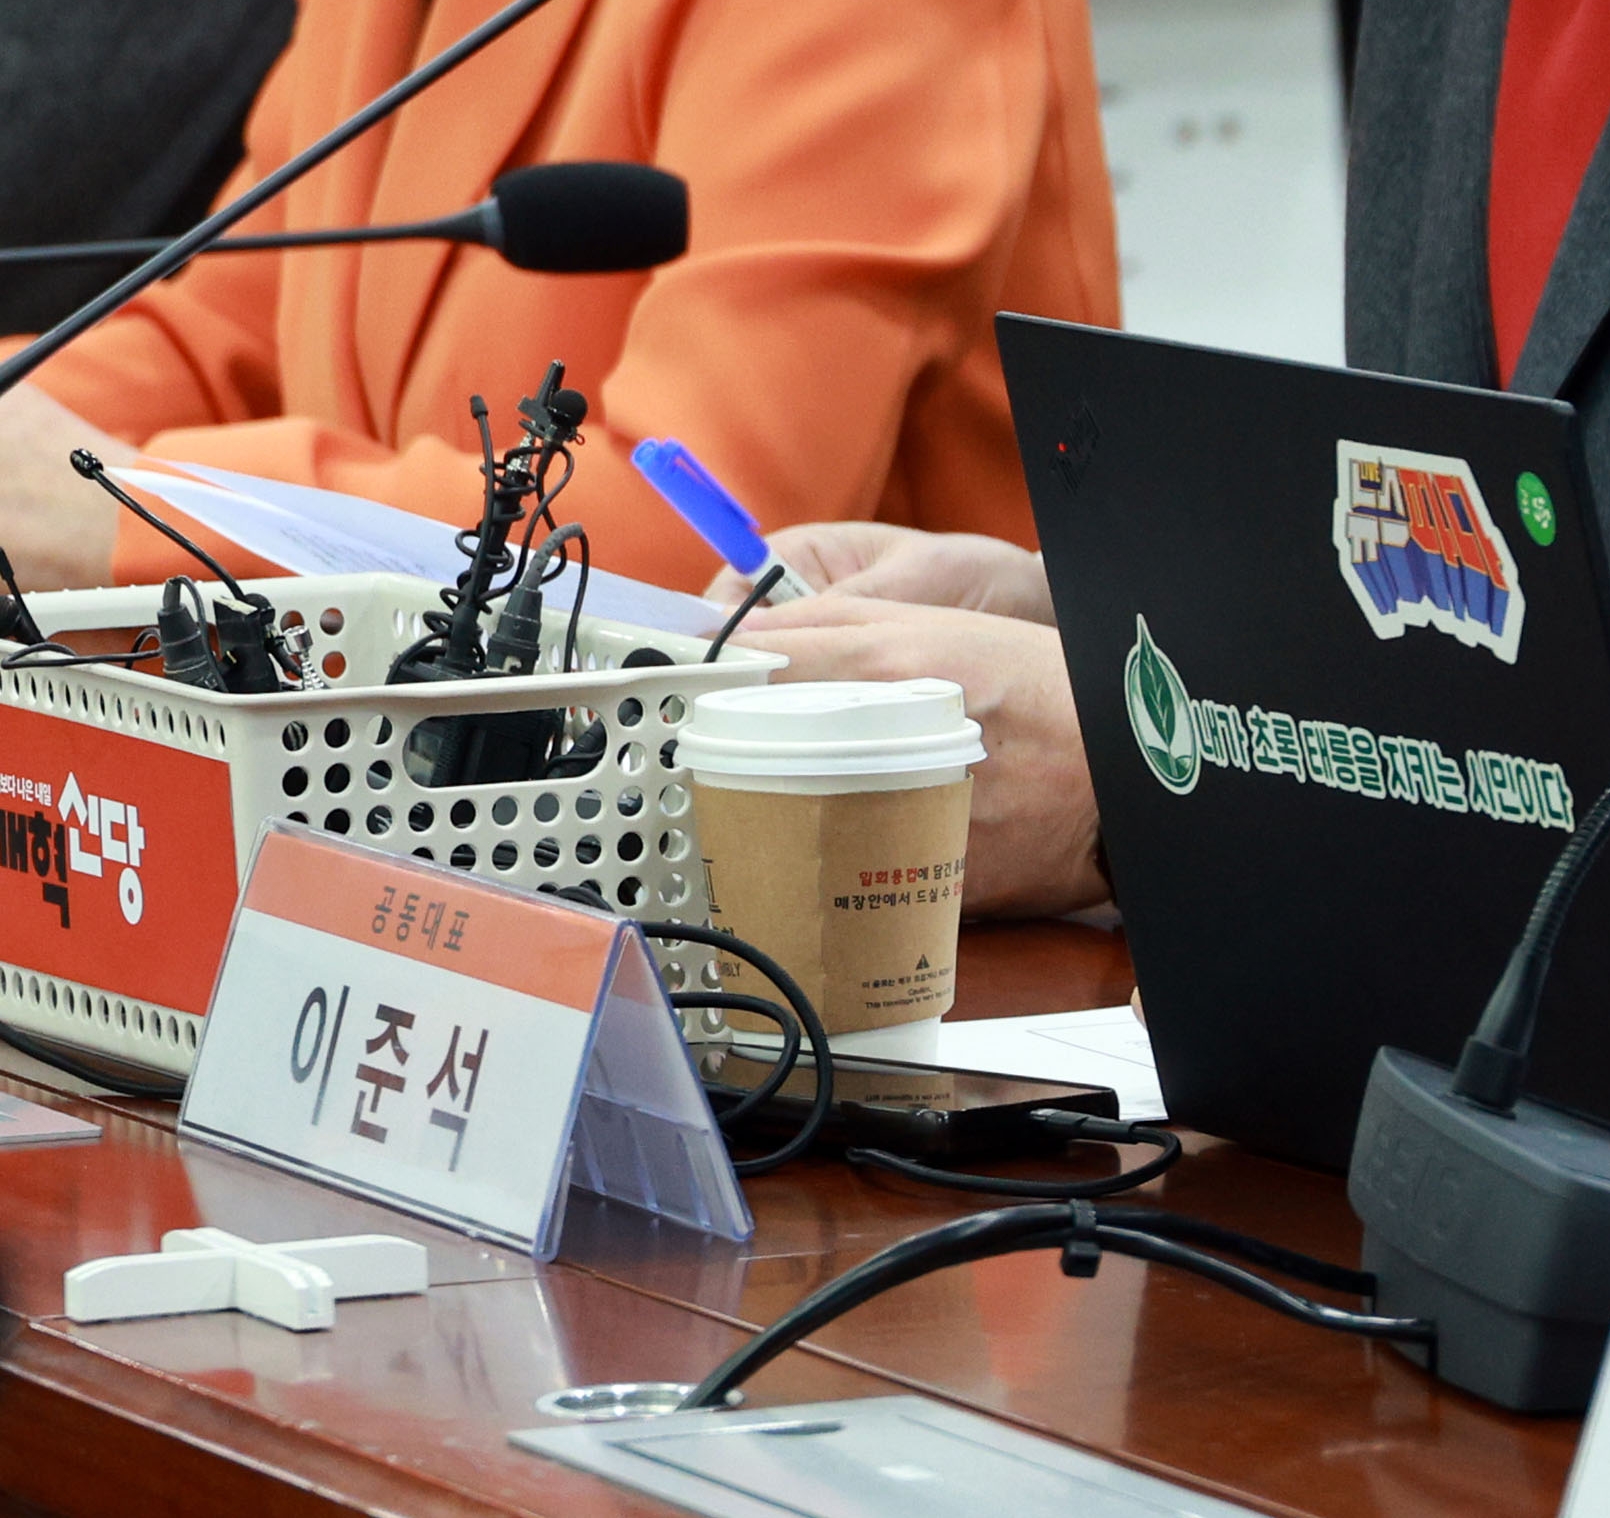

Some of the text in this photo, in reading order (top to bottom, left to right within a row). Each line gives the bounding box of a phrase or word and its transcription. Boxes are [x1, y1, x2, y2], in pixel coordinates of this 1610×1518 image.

[17, 777, 34, 802] 나은
[35, 782, 52, 807] 내일
[1198, 704, 1575, 831] 내가 초록 태릉을 지키는 시민이다
[371, 885, 471, 952] 공동대표
[290, 984, 490, 1174] 이준석
